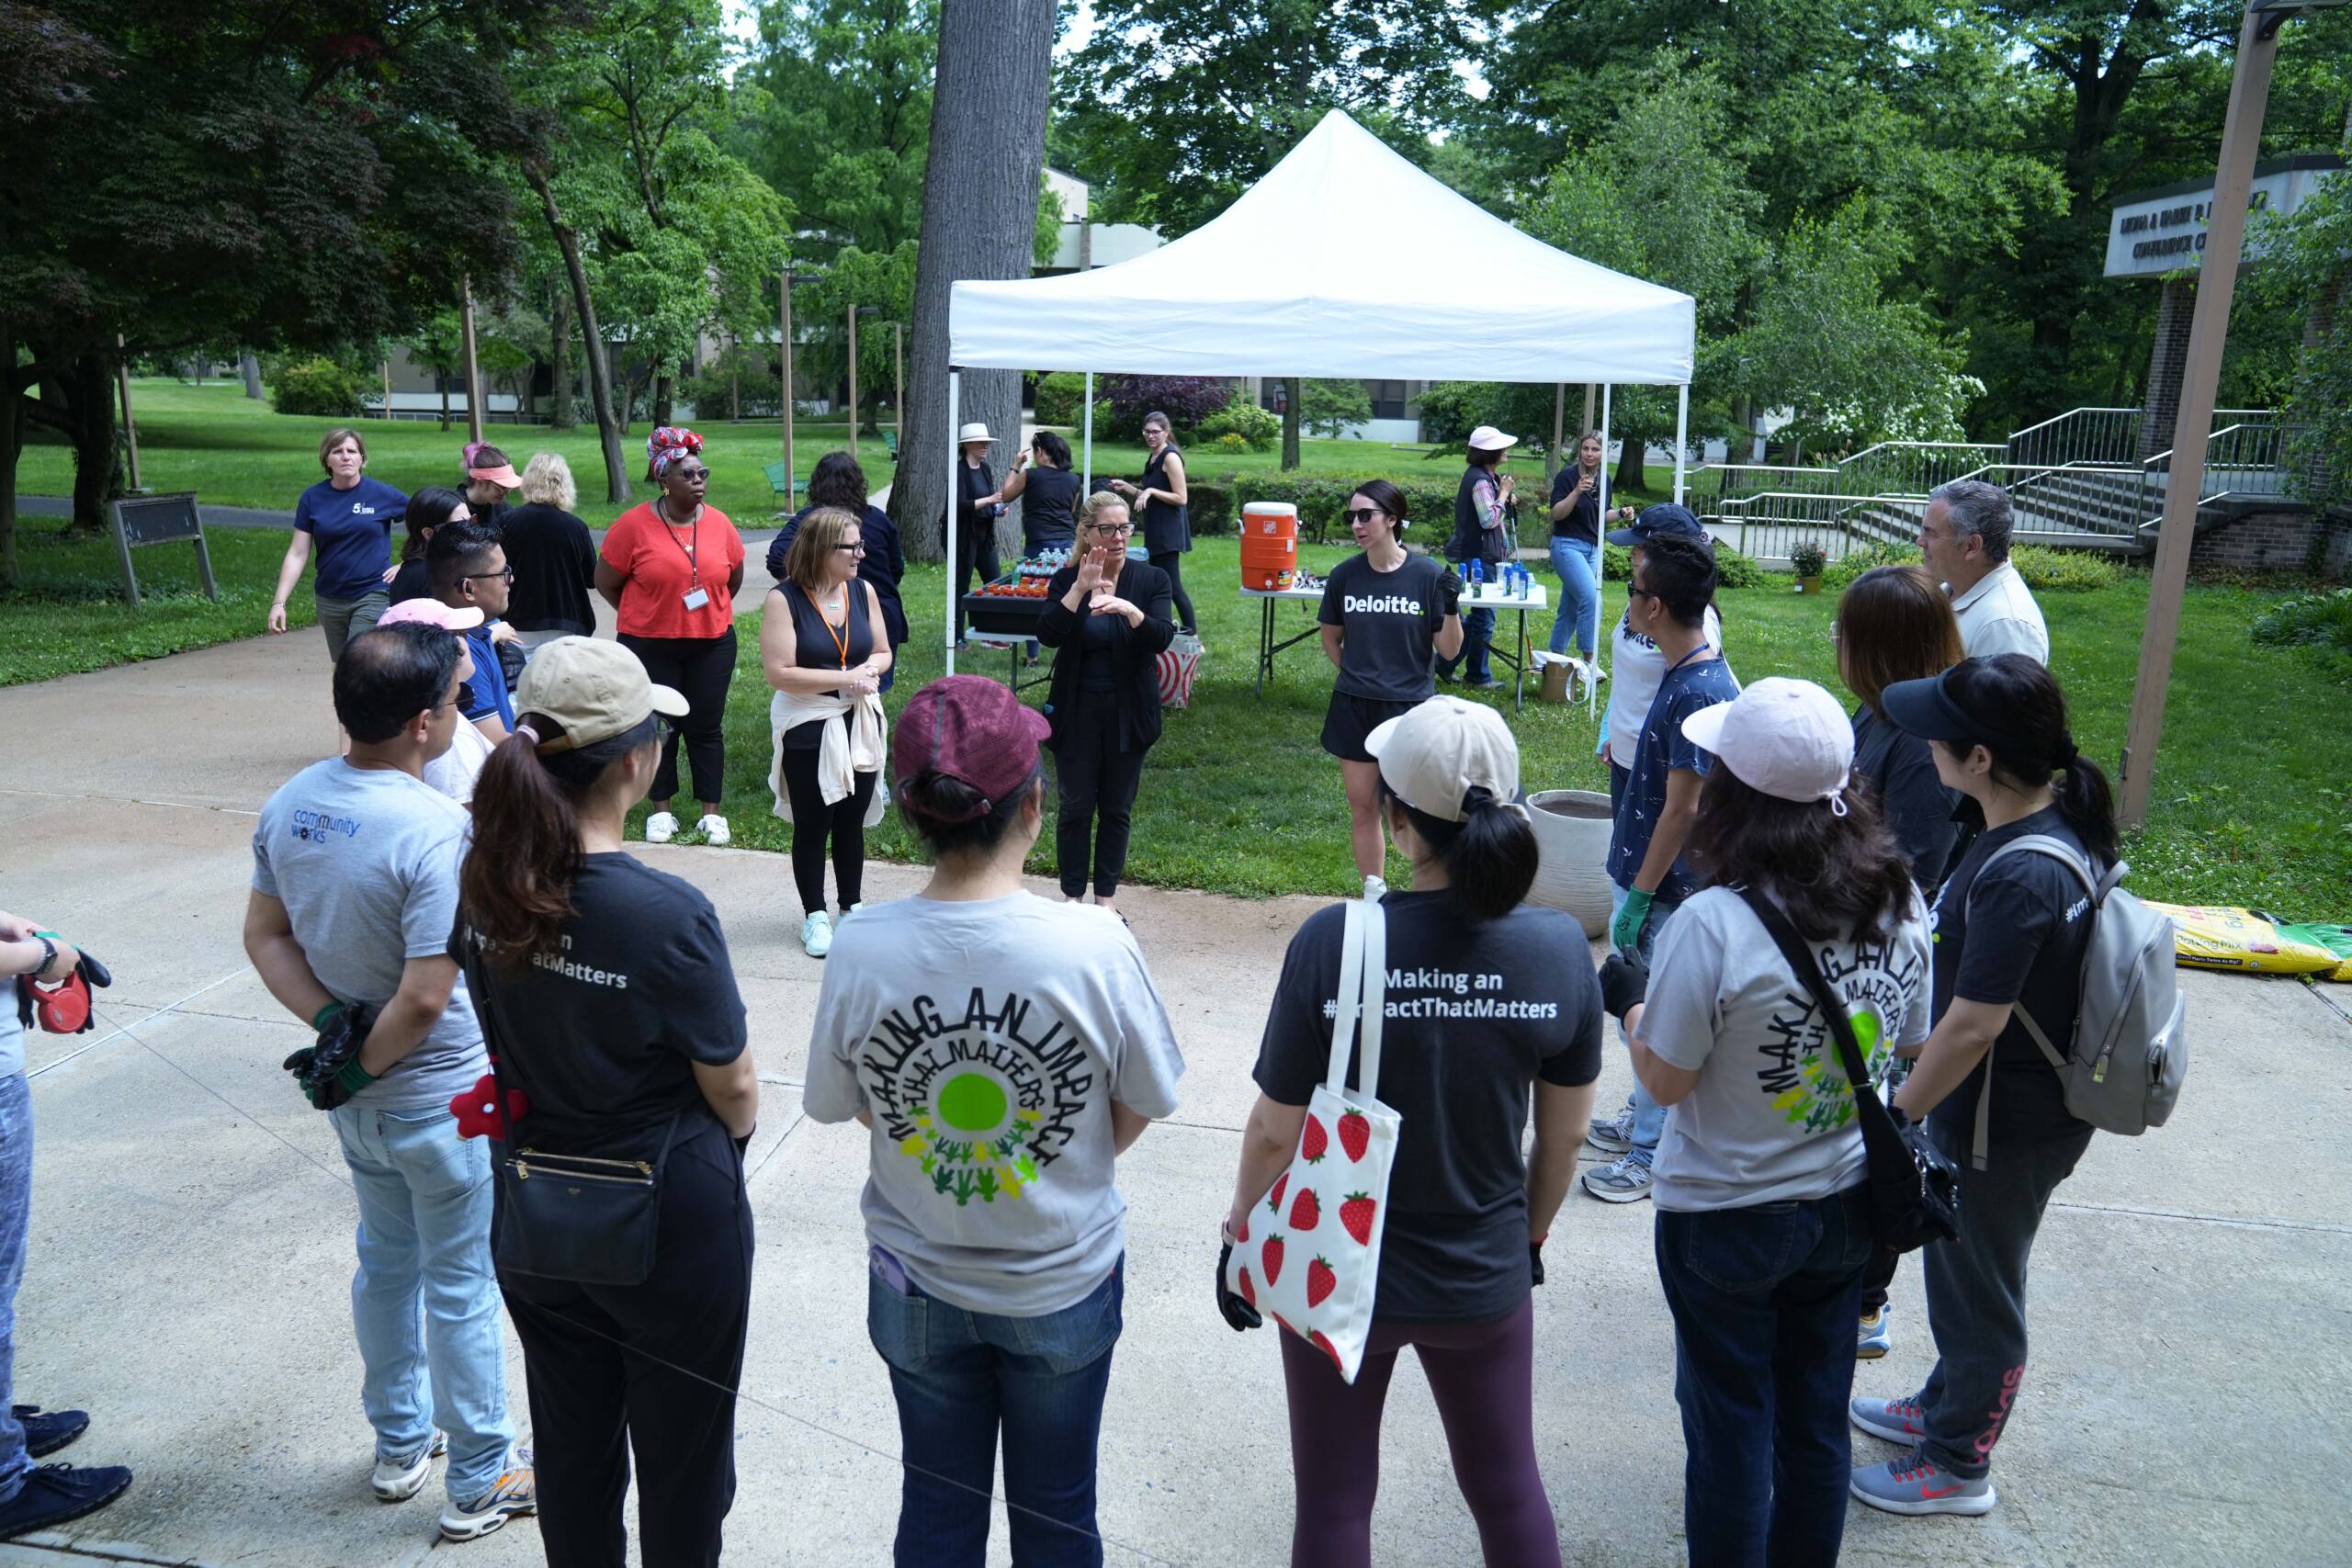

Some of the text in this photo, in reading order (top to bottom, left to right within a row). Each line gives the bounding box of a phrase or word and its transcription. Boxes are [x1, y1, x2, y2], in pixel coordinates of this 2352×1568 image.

[1344, 595, 1424, 615] Deloitte.
[291, 824, 325, 844] works
[294, 810, 361, 838] community
[2221, 941, 2243, 950] Mix
[1385, 967, 1503, 995] Making an
[864, 987, 1093, 1168] MAKING AN IMPACT
[902, 1038, 1046, 1111] THAT MATTERS
